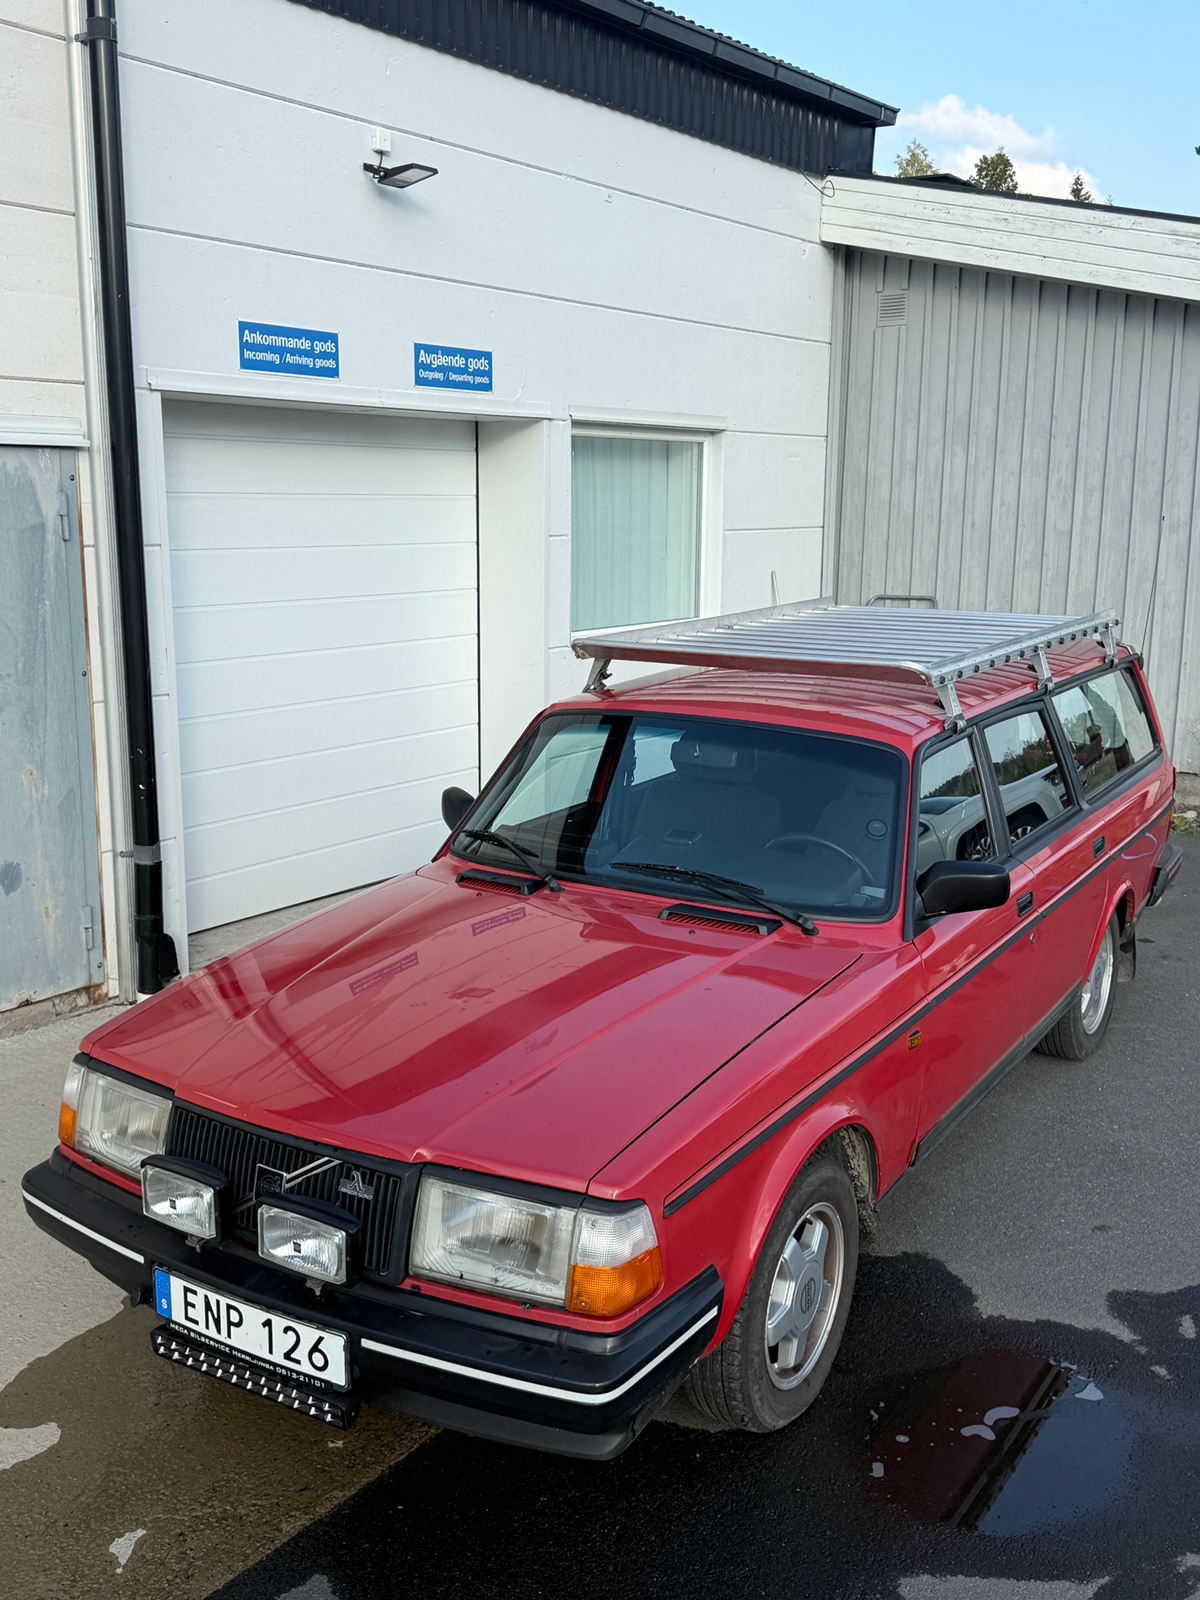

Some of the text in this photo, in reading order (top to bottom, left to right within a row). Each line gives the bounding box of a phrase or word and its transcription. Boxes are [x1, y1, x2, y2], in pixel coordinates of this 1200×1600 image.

[243, 329, 336, 354] Ankommande gods
[243, 348, 280, 364] Incoming
[315, 358, 336, 369] goods
[418, 349, 489, 372] Avgående gods
[418, 368, 444, 381] Outgoing
[448, 371, 474, 384] Departing
[474, 375, 490, 385] goods
[160, 1298, 168, 1310] S
[182, 1284, 329, 1373] ENP 126
[189, 1331, 231, 1353] BILSERVICE
[275, 1366, 325, 1389] 0513-21101
